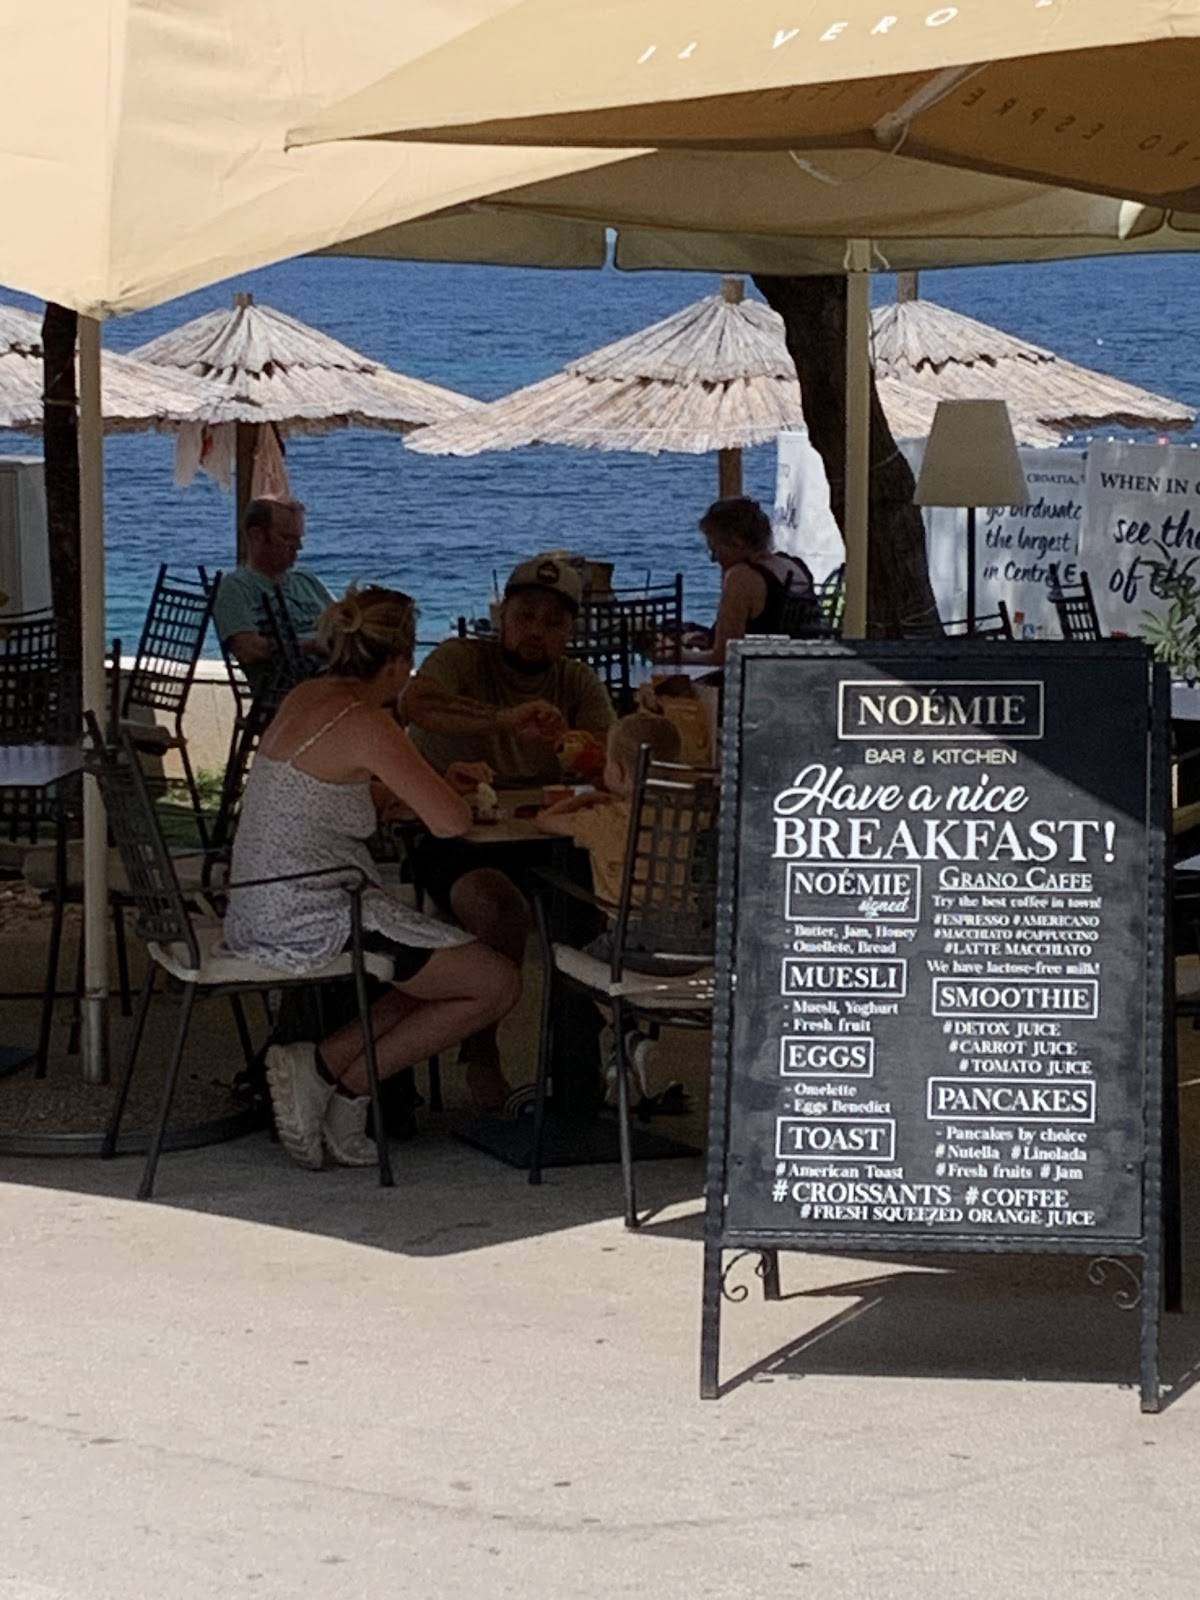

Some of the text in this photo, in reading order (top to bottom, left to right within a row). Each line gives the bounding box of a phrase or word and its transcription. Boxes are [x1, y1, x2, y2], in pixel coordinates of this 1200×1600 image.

[771, 7, 959, 49] VERO
[1100, 472, 1161, 493] WHEN
[1165, 478, 1189, 495] IN
[1113, 518, 1152, 545] see
[984, 525, 1071, 561] the largest
[983, 562, 999, 580] in
[1004, 560, 1062, 588] Centr
[1109, 556, 1143, 604] of
[858, 688, 1027, 726] NOÉMIE
[865, 749, 1017, 765] BAR & KITCHEN
[773, 764, 1029, 815] Have a nice
[771, 817, 1116, 862] BREAKFAST!
[793, 868, 911, 896] NOÉMIE
[931, 895, 954, 909] Try
[958, 896, 979, 908] the
[982, 896, 1007, 908] best
[1010, 897, 1050, 909] coffee
[1052, 897, 1064, 909] in
[934, 913, 1100, 928] #ESPRESSO #AMERICANO
[876, 926, 917, 942] Honey
[934, 928, 1012, 941] #MACCHIATO
[858, 941, 896, 954] Bread
[944, 943, 1092, 957] #LATTE MACCHIATO
[926, 959, 1100, 975] We have lactose-free milk!
[789, 966, 897, 989] MUESLI
[940, 986, 1090, 1010] SMOOTHIE
[793, 1000, 899, 1017] Muesli, Yoghurt
[793, 1018, 871, 1032] Fresh fruit
[943, 1021, 1061, 1038] #DETOX JUICE
[788, 1045, 866, 1068] EGGS
[949, 1040, 1078, 1057] #CARROT JUICE
[959, 1058, 1093, 1076] #TOMATO JUICE
[793, 1082, 857, 1097] Omelette
[793, 1100, 891, 1115] Eggs Benedict
[937, 1087, 1088, 1113] PANCAKES
[788, 1126, 886, 1151] TOAST
[945, 1125, 1087, 1144] Pancakes by choice
[864, 1165, 904, 1179] Toast
[992, 1163, 1033, 1179] fruits
[800, 1203, 868, 1220] #FRESH
[968, 1208, 1042, 1224] ORANGE
[1042, 1210, 1096, 1227] JUICE
